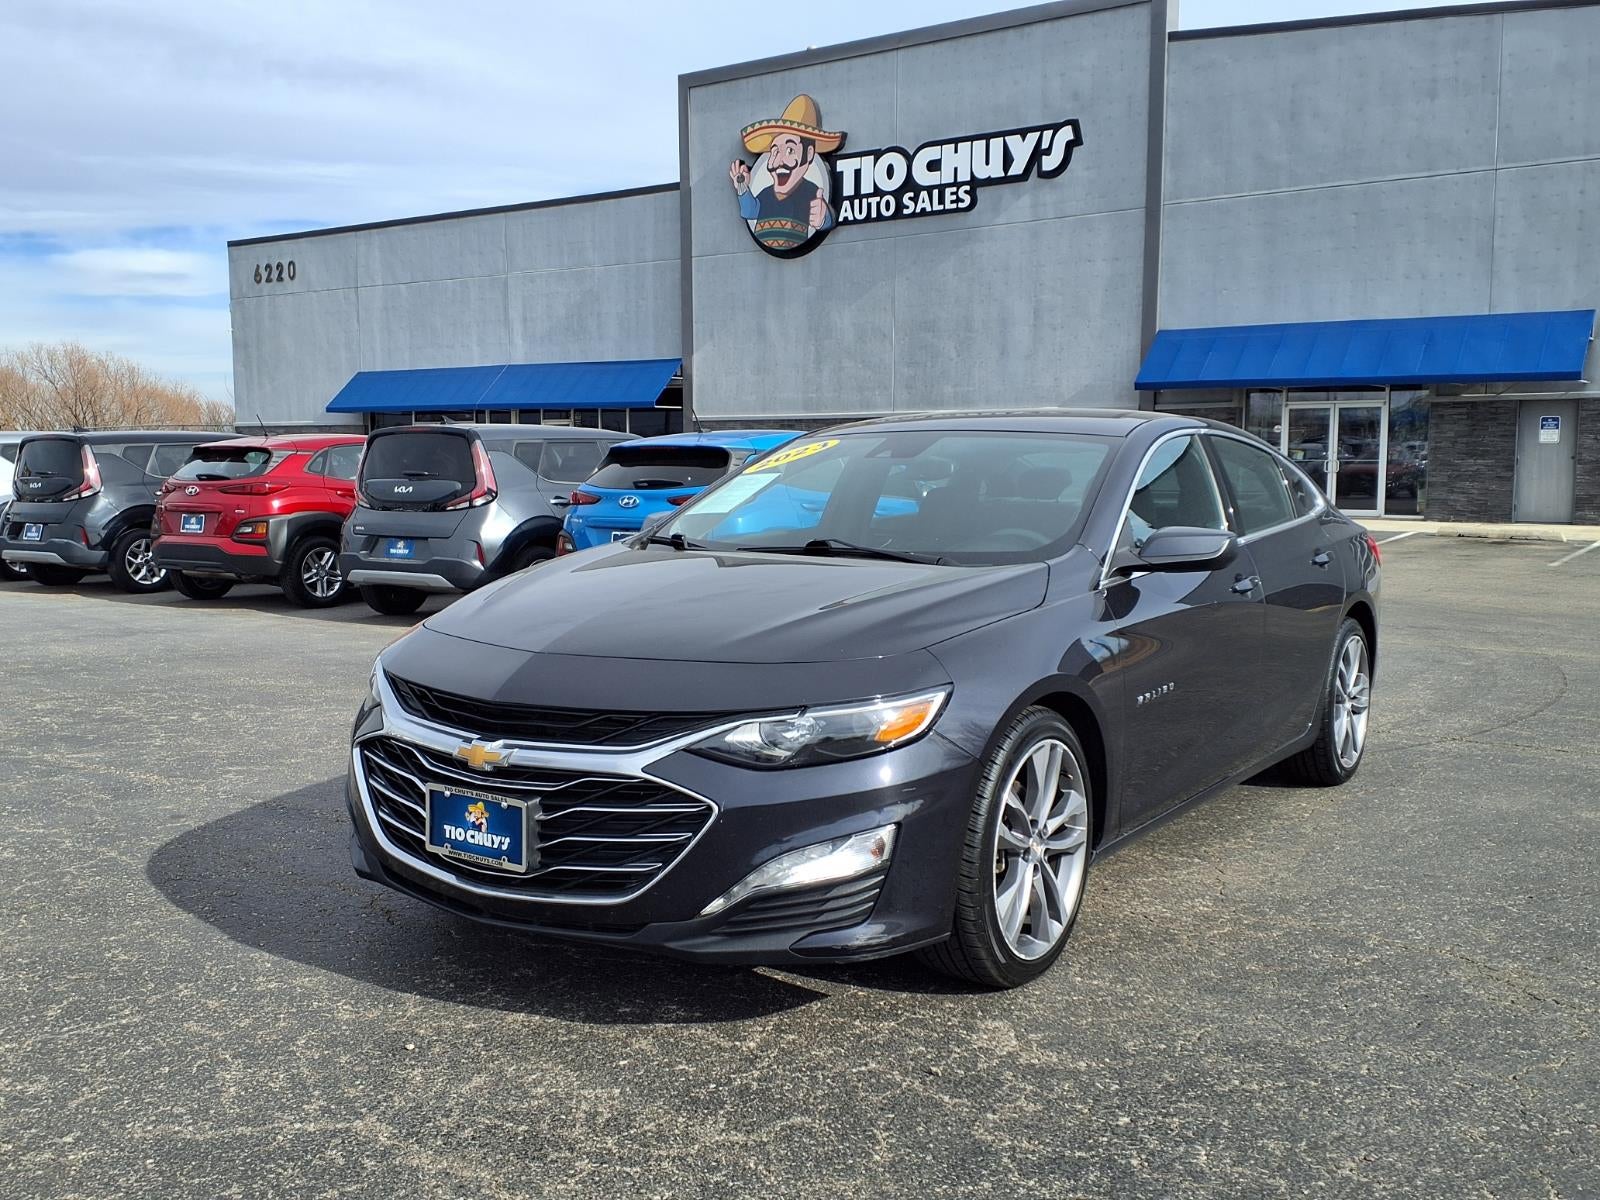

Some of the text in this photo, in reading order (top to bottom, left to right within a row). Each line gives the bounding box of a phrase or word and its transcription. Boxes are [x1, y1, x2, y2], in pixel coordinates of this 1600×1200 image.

[836, 125, 1074, 197] TIO CHUY'S
[838, 185, 971, 222] AUTO SALES
[253, 260, 296, 285] 6220
[394, 485, 413, 493] KIA
[475, 792, 490, 800] AUTO
[443, 824, 511, 851] TIO CHUY'S
